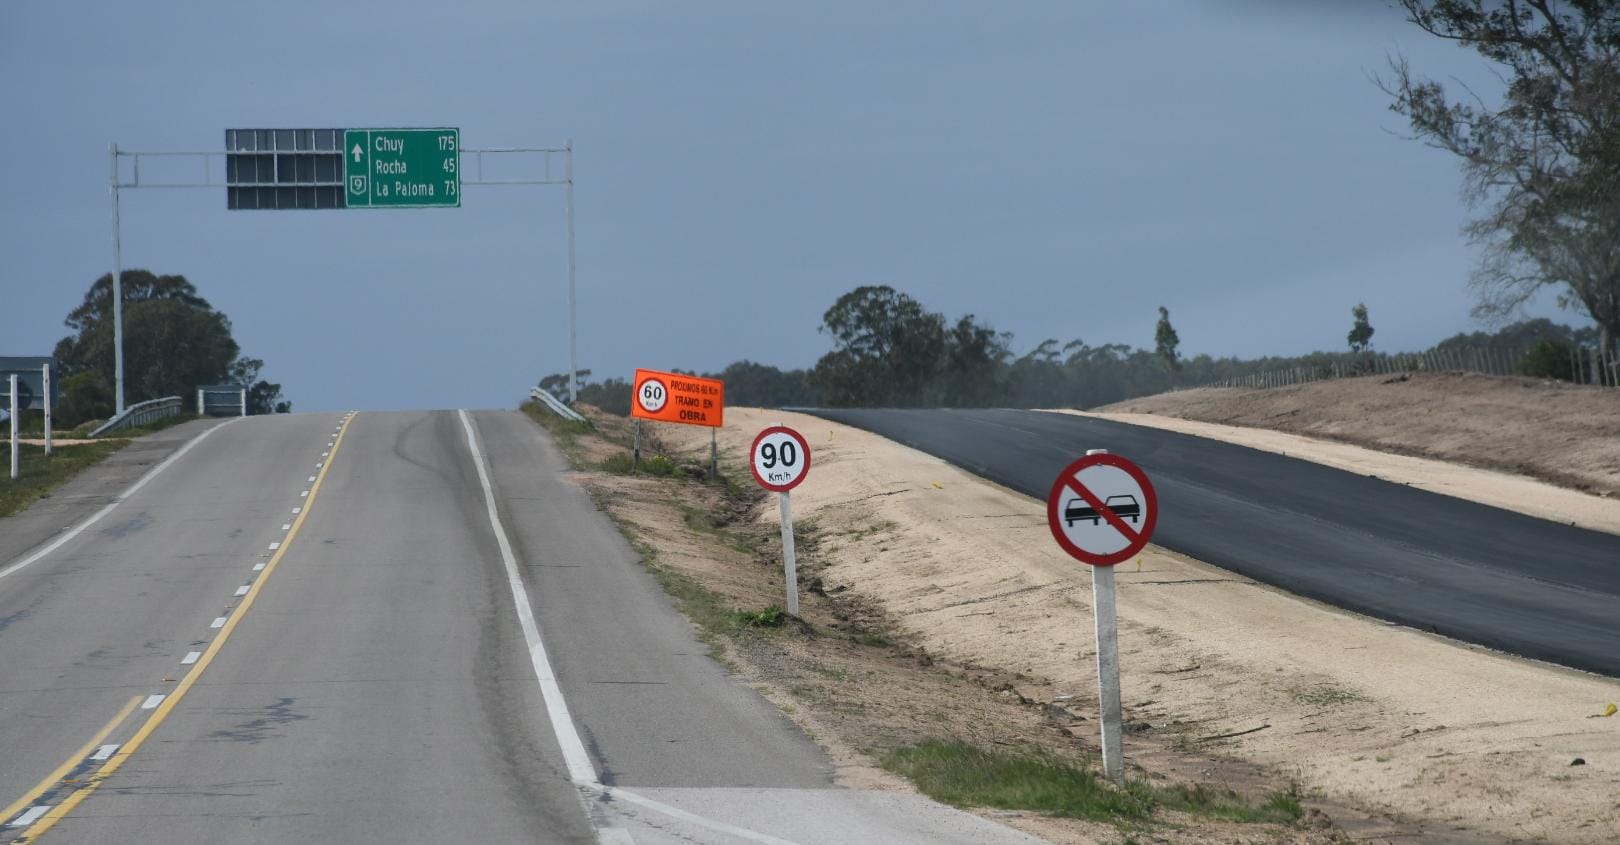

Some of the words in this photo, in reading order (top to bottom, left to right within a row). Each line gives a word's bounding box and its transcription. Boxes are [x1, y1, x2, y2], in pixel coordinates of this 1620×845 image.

[375, 136, 404, 155] Chuy
[438, 136, 455, 151] 175
[376, 159, 407, 174] Rocha
[443, 158, 455, 173] 45
[354, 178, 363, 191] 9
[376, 181, 389, 196] La
[395, 181, 434, 197] Paloma
[444, 180, 456, 196] 73
[644, 385, 662, 400] 60
[675, 395, 700, 407] TRAMO
[703, 399, 713, 409] EN
[679, 410, 707, 422] OBRA
[761, 441, 796, 469] 90
[768, 472, 792, 482] Km/h
